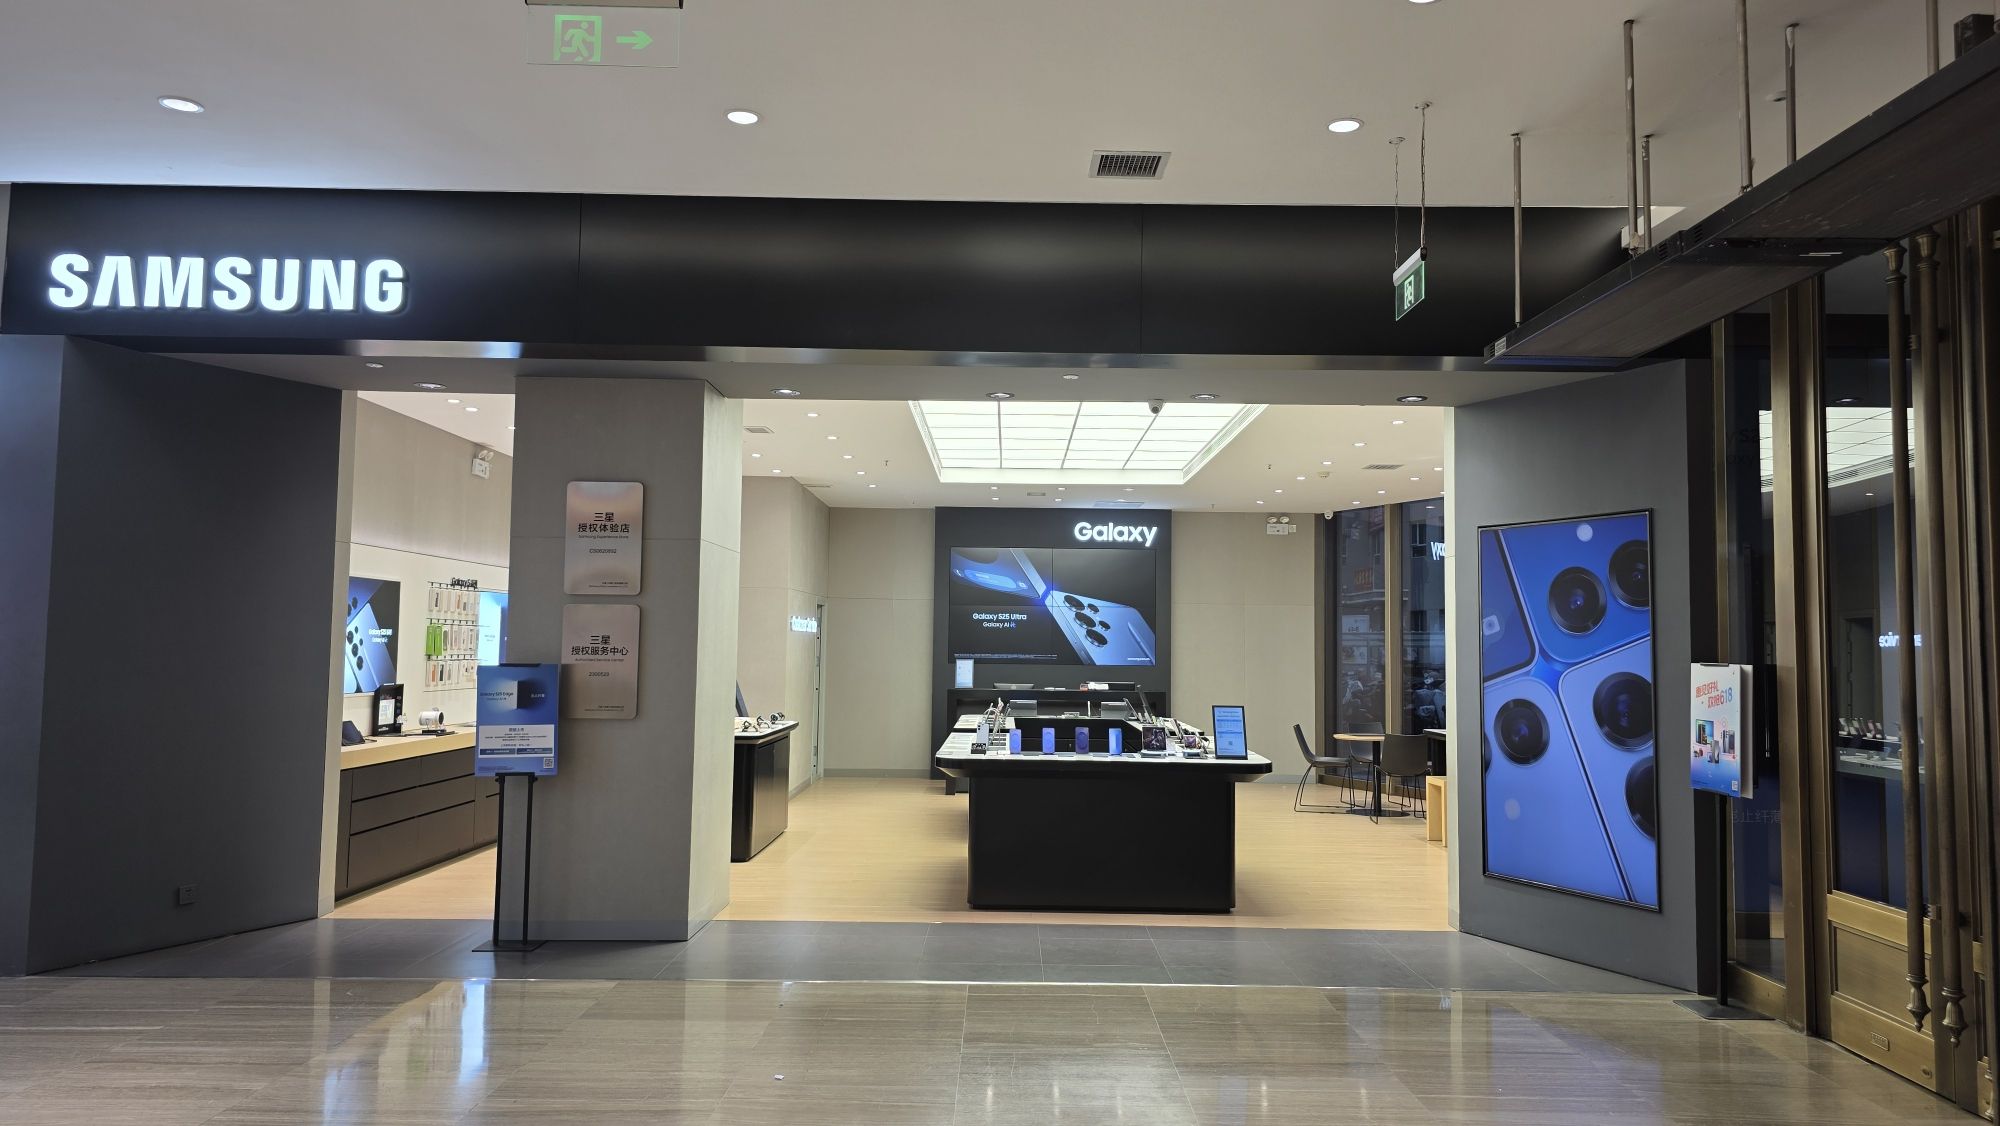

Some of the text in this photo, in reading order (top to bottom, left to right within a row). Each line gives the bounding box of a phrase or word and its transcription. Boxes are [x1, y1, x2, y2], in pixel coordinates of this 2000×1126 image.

[48, 252, 406, 313] SAMSUNG
[594, 512, 614, 522] 三星
[577, 523, 630, 533] 授权体验店
[1074, 521, 1158, 547] Galaxy
[972, 612, 998, 622] Galaxy
[1010, 613, 1027, 621] Ultra
[982, 621, 1004, 629] Galaxy
[589, 635, 611, 645] 三星
[571, 646, 629, 656] 授权服务中心
